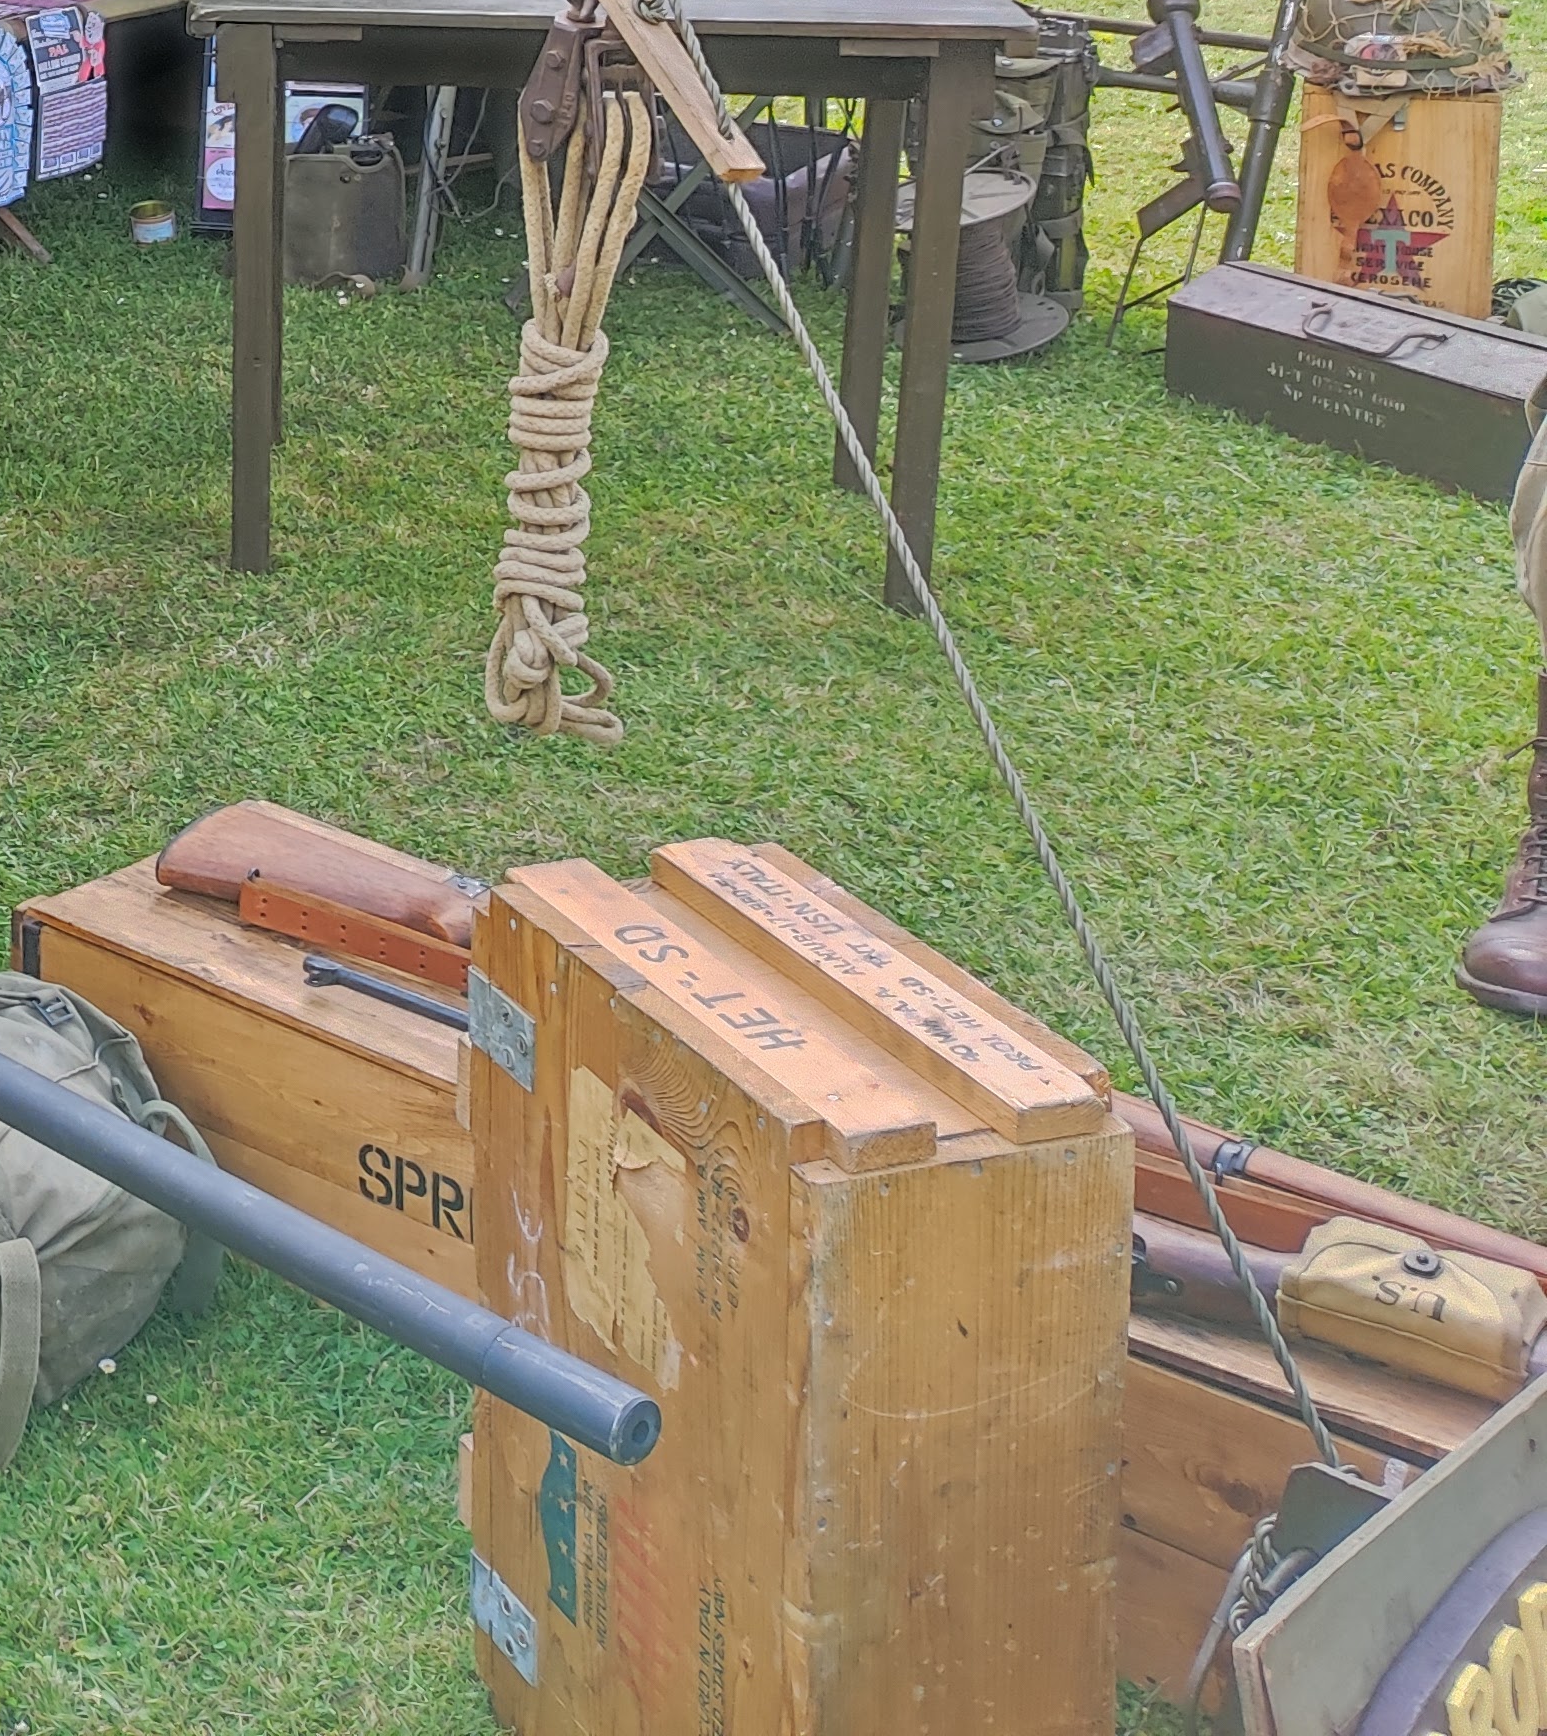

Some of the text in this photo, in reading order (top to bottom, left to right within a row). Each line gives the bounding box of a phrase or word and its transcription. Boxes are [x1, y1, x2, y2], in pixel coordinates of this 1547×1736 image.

[582, 1576, 595, 1631] FROM
[595, 1492, 609, 1651] MUTUAL DEFENSE
[699, 1576, 713, 1665] IN ITALY
[712, 1628, 727, 1704] STATES
